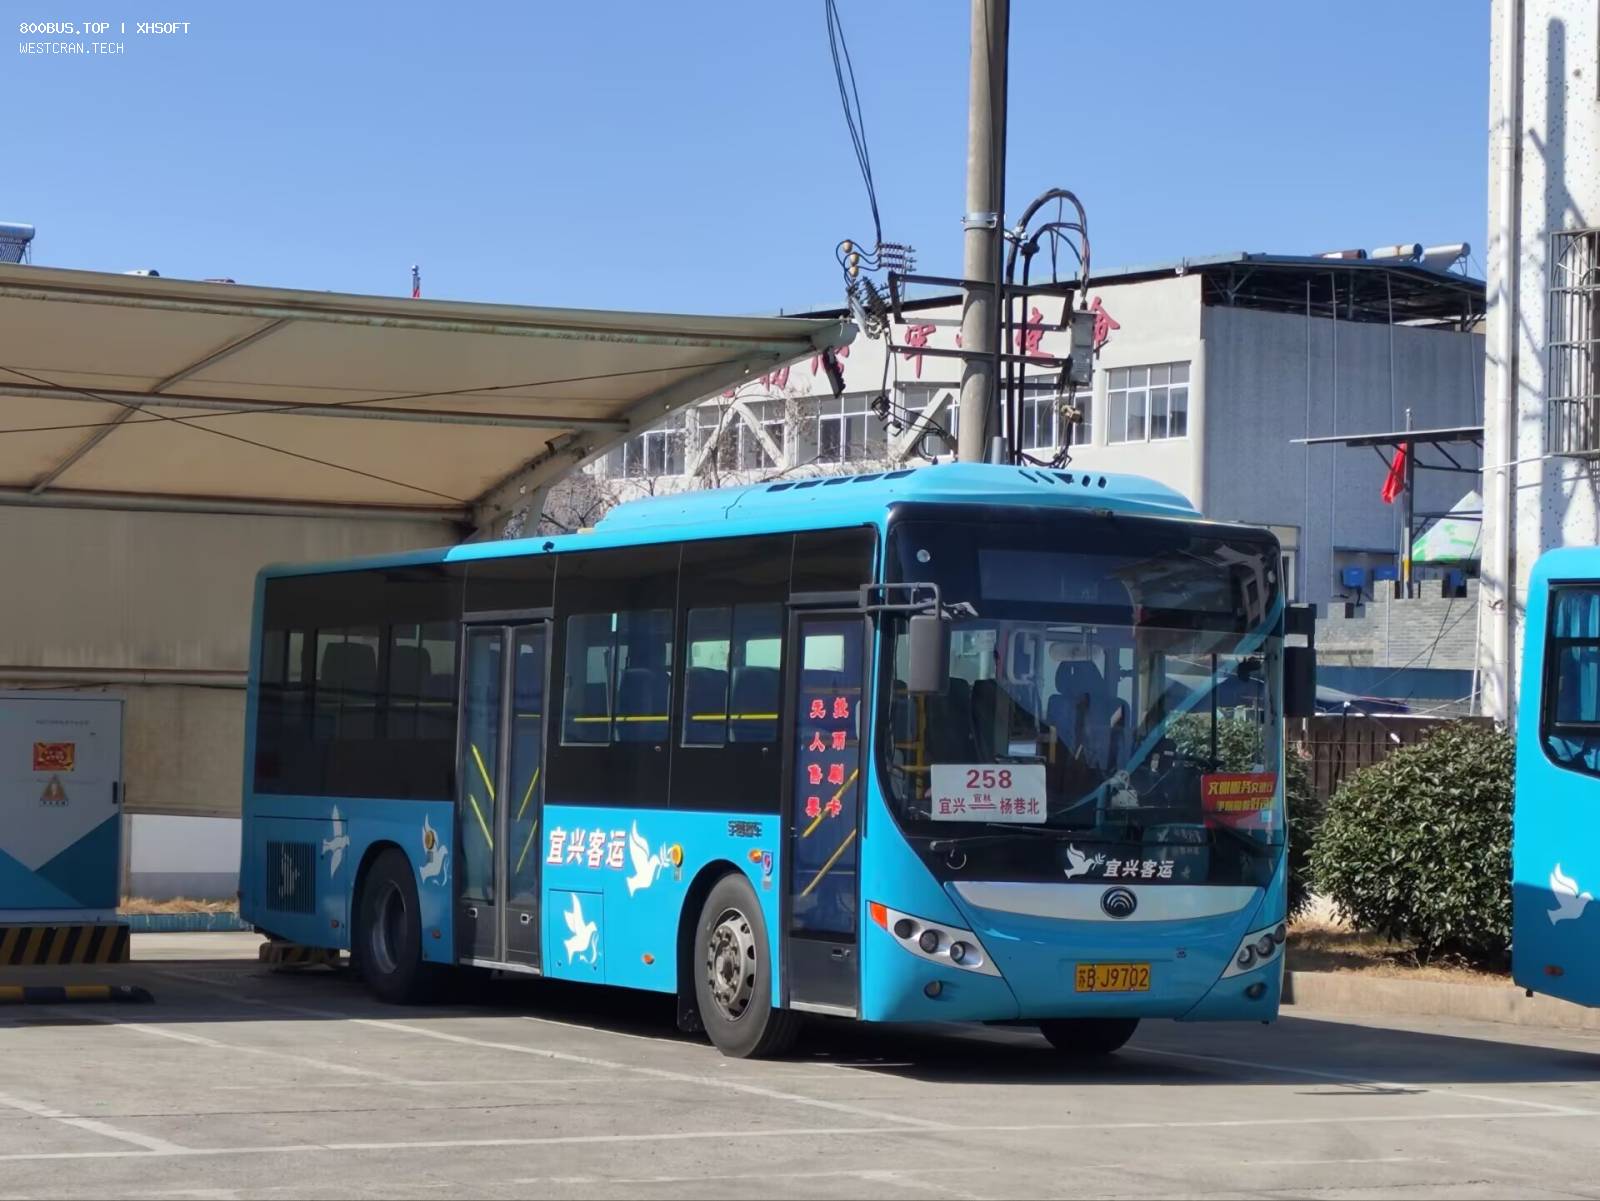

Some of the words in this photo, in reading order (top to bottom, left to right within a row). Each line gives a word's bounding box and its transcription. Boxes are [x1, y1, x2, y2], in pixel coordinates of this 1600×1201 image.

[965, 769, 1012, 789] 258
[939, 797, 966, 815] 宜兴
[999, 797, 1039, 816] 杨巷北
[546, 826, 627, 869] 宜兴客运
[1102, 859, 1175, 879] 宜兴客运
